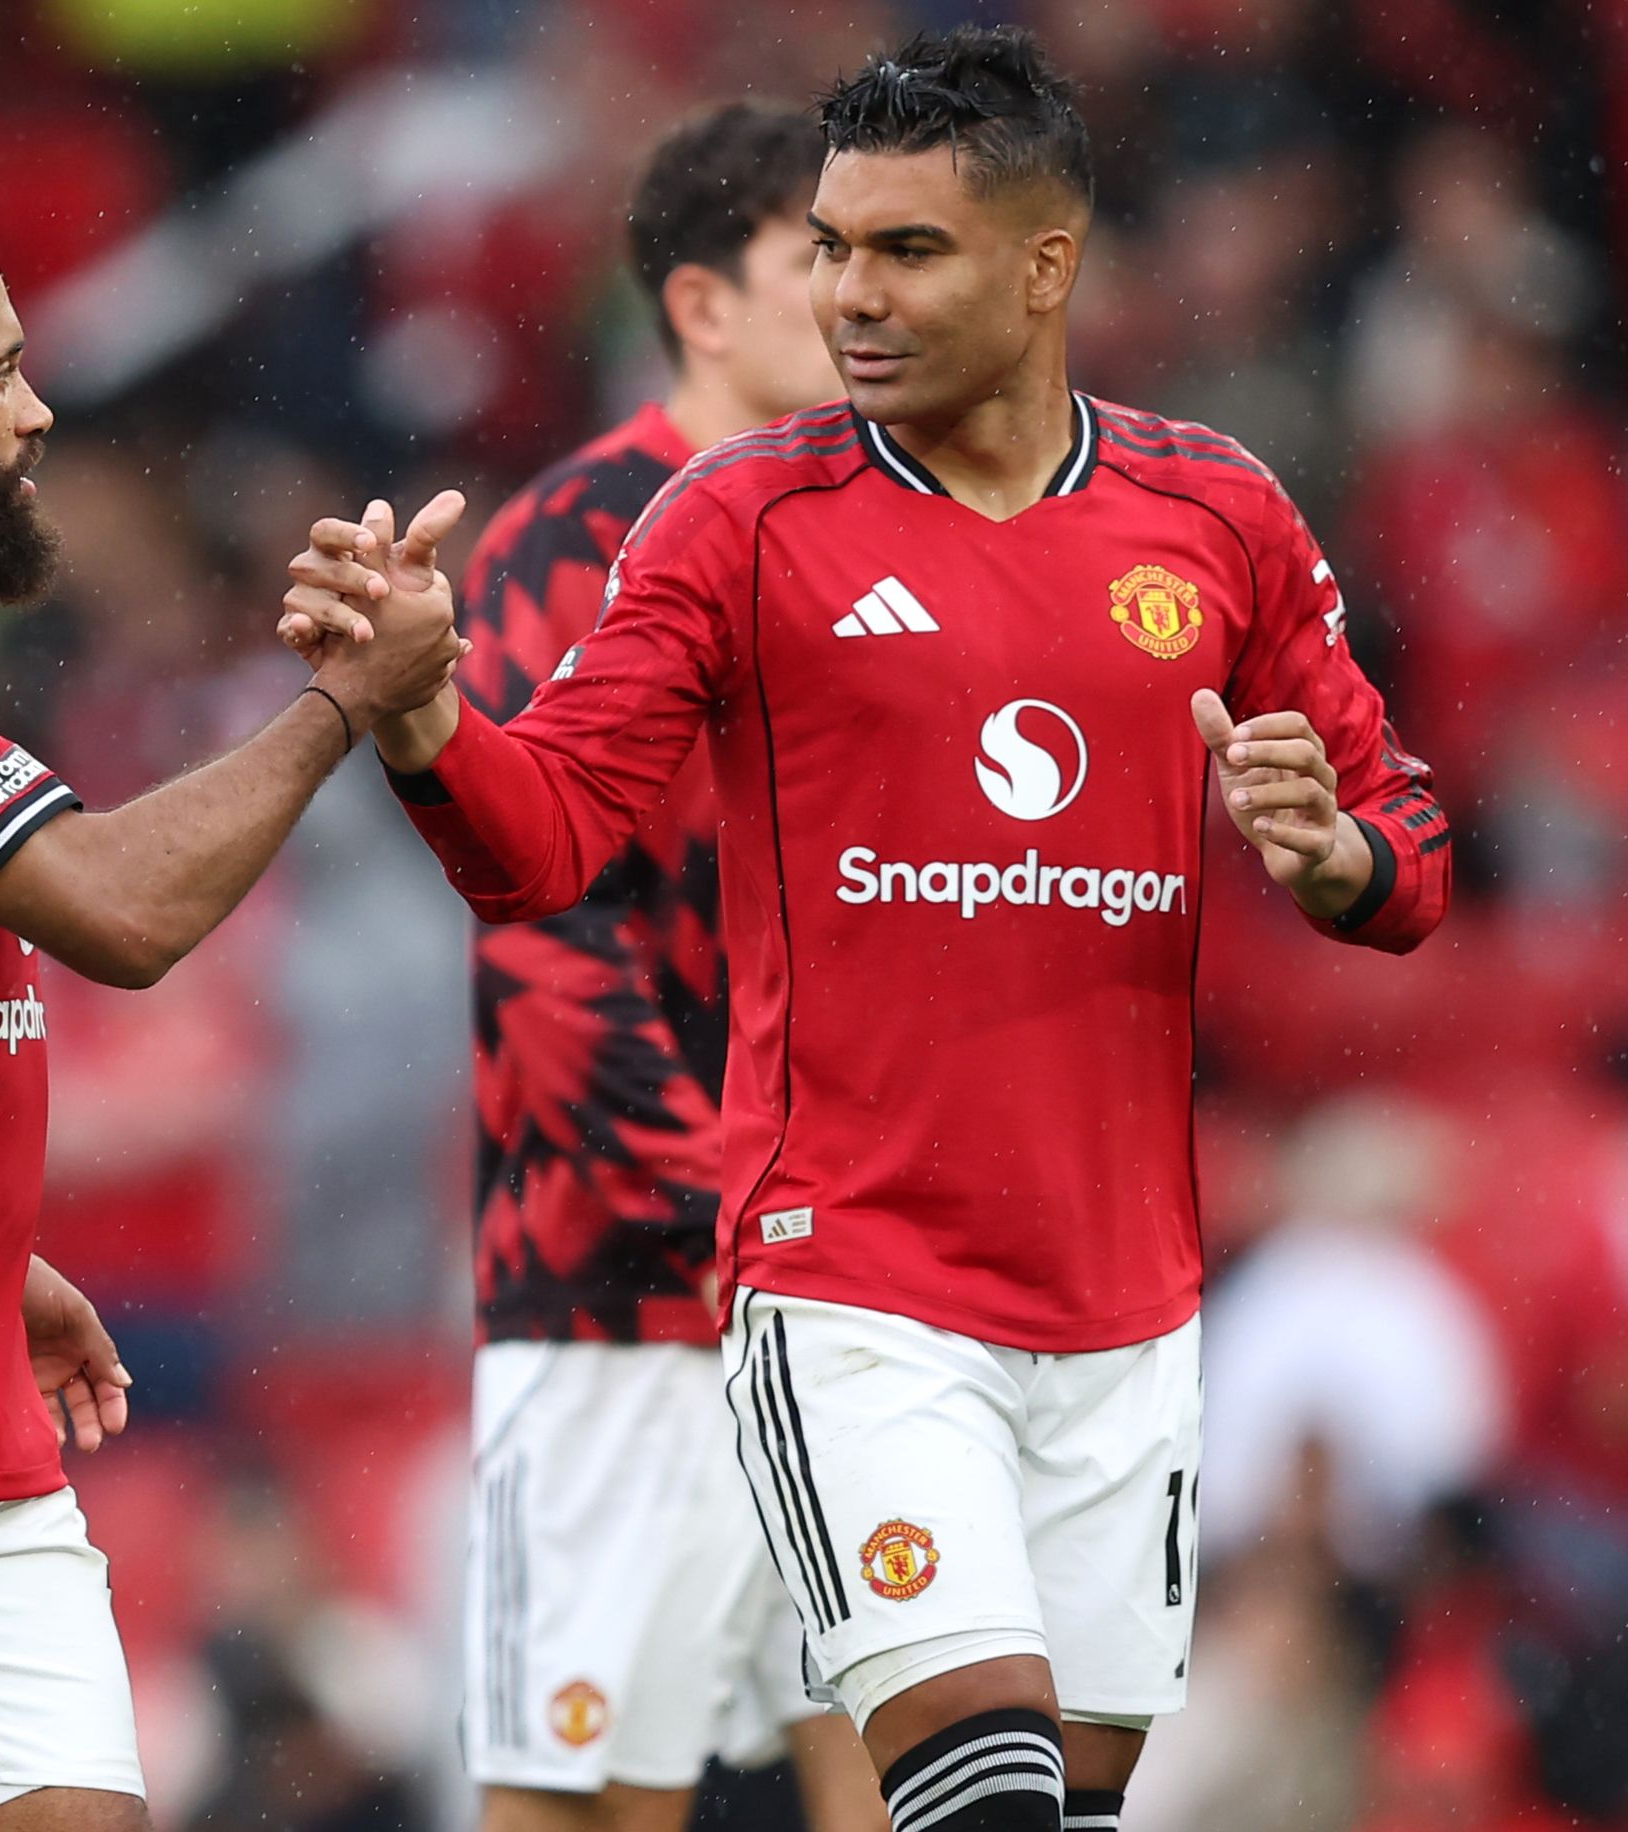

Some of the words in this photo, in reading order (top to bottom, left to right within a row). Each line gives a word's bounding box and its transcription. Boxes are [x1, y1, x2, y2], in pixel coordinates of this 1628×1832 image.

[1116, 571, 1194, 602] MANCHESTER
[1137, 634, 1190, 653] UNITED
[835, 845, 1187, 927] Snapdragon
[864, 1524, 929, 1559] MANCHESTER
[1165, 1469, 1199, 1607] 1
[882, 1576, 928, 1597] UNITED
